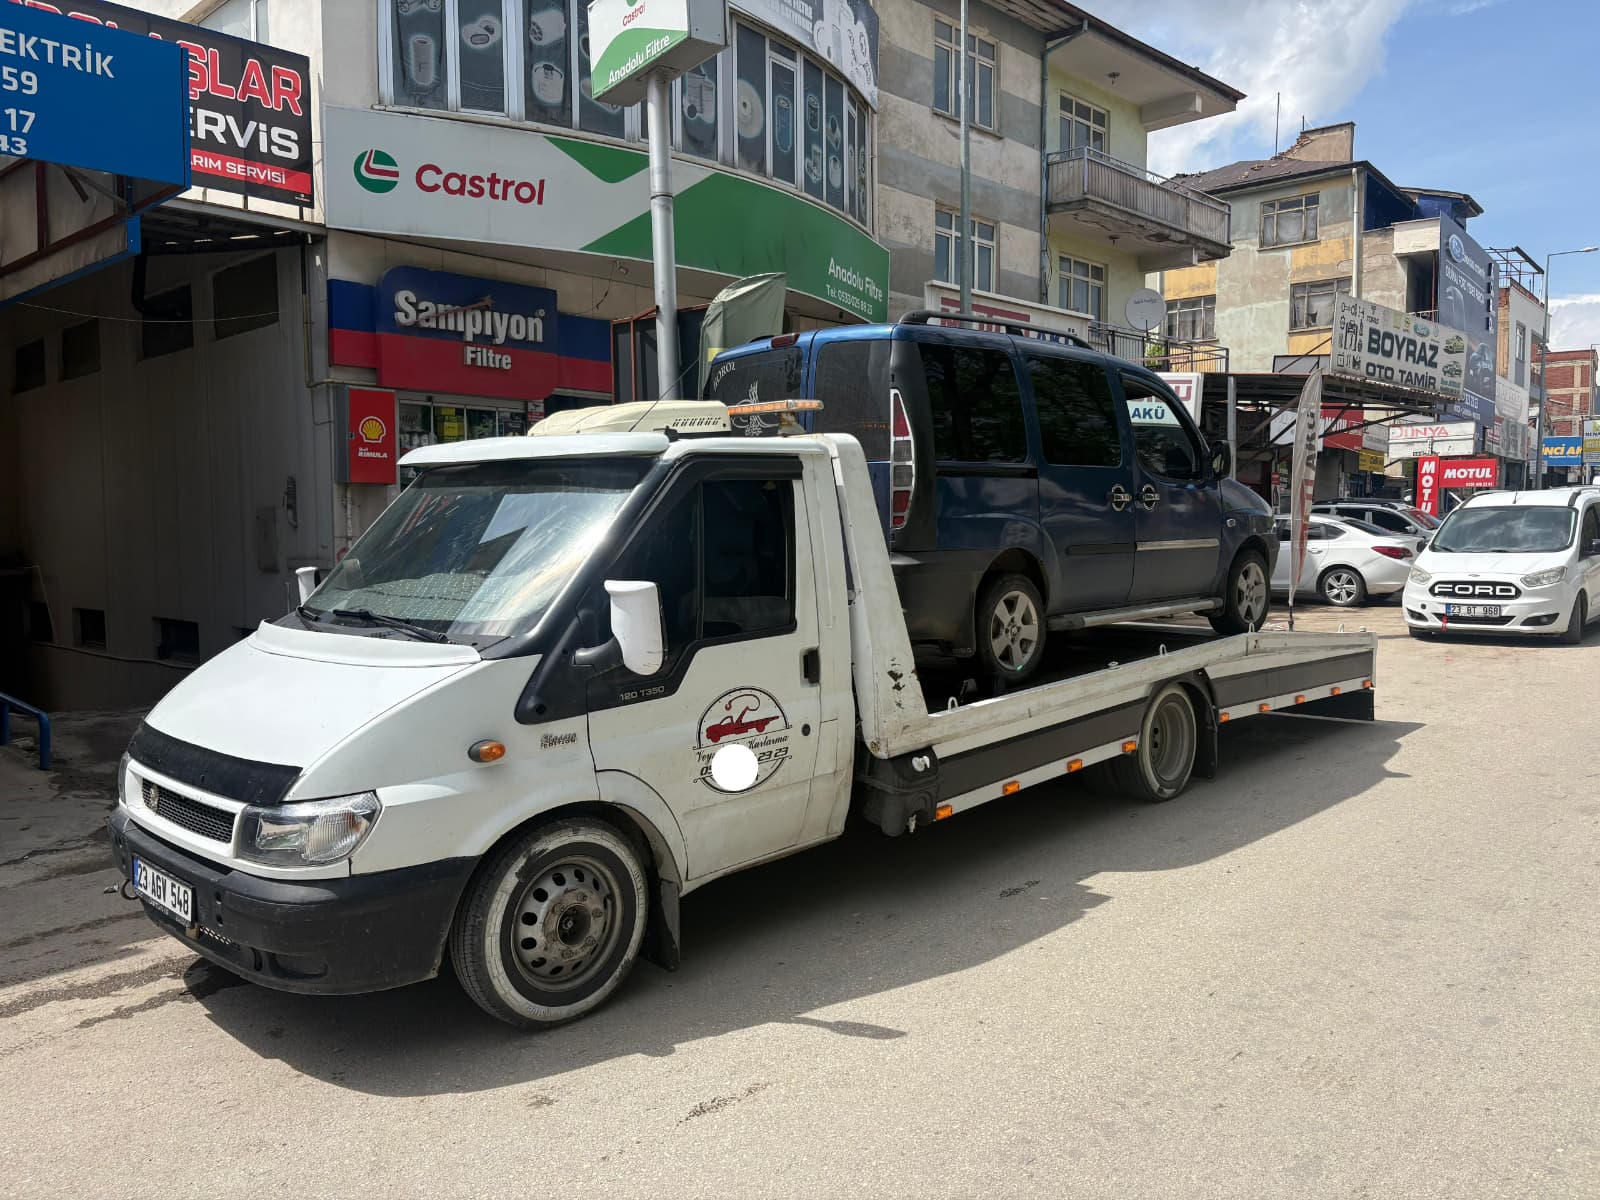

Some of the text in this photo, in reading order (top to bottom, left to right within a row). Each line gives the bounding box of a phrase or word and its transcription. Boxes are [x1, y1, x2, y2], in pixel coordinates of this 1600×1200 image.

[622, 2, 646, 26] Castrol
[608, 35, 670, 85] Anadolu Filtre
[2, 65, 38, 95] 59
[4, 107, 36, 134] 17
[191, 154, 286, 185] RIM SERVİSİ
[415, 163, 545, 205] Castrol
[828, 257, 883, 302] Anadolu Filtre
[464, 346, 512, 370] Filtre
[1367, 327, 1439, 369] BOYRAZ
[1365, 361, 1395, 381] OTO
[1398, 369, 1437, 390] TAMİR
[1132, 405, 1165, 420] AKÜ
[1443, 467, 1493, 479] MOTUL
[1434, 584, 1516, 596] FORD
[1452, 606, 1461, 614] 23
[758, 750, 773, 762] 23
[773, 746, 789, 758] 23
[138, 863, 148, 890] 23
[151, 871, 167, 903] AGV
[170, 882, 189, 915] 548
